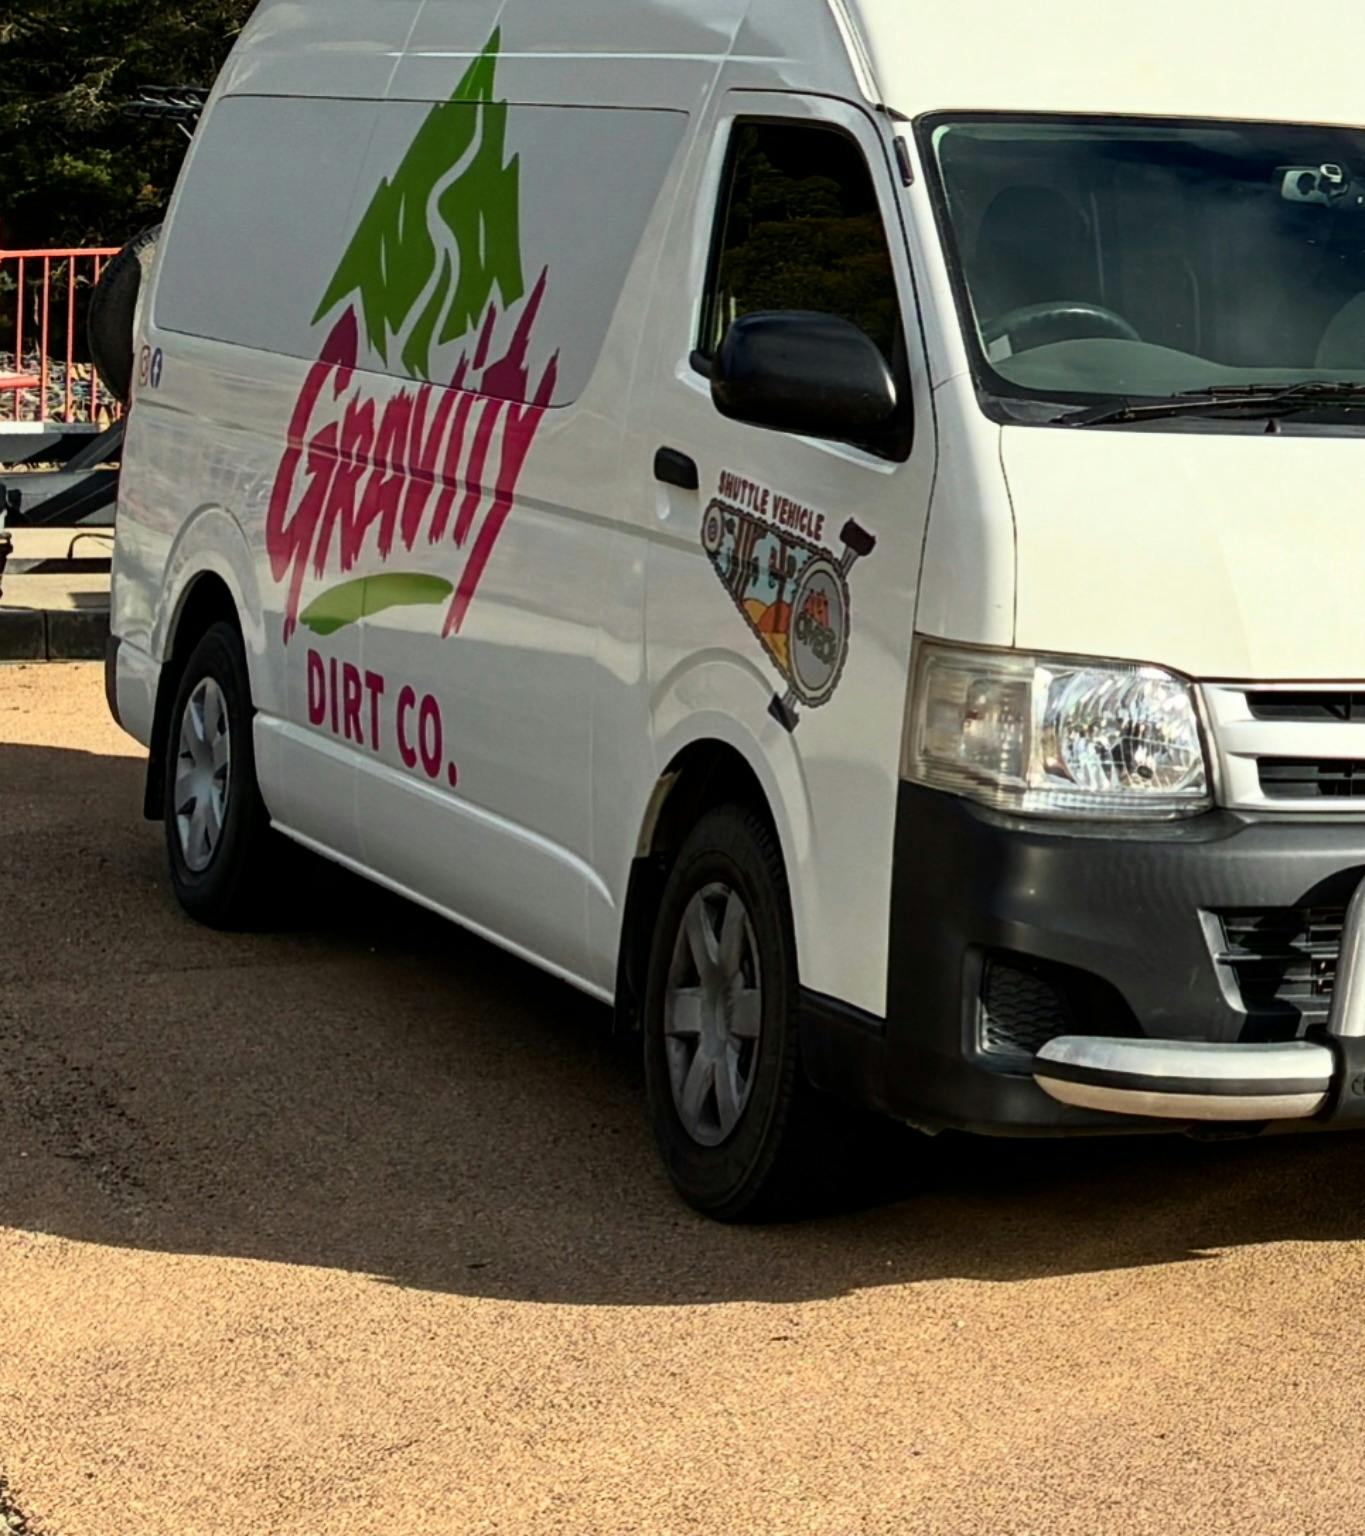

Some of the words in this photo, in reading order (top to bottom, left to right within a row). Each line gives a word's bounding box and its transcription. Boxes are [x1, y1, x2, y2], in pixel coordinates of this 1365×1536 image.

[718, 470, 769, 515] SHUTTLE
[773, 493, 825, 542] VEHICLE
[307, 648, 384, 752] DIRT
[396, 684, 458, 787] CO.
